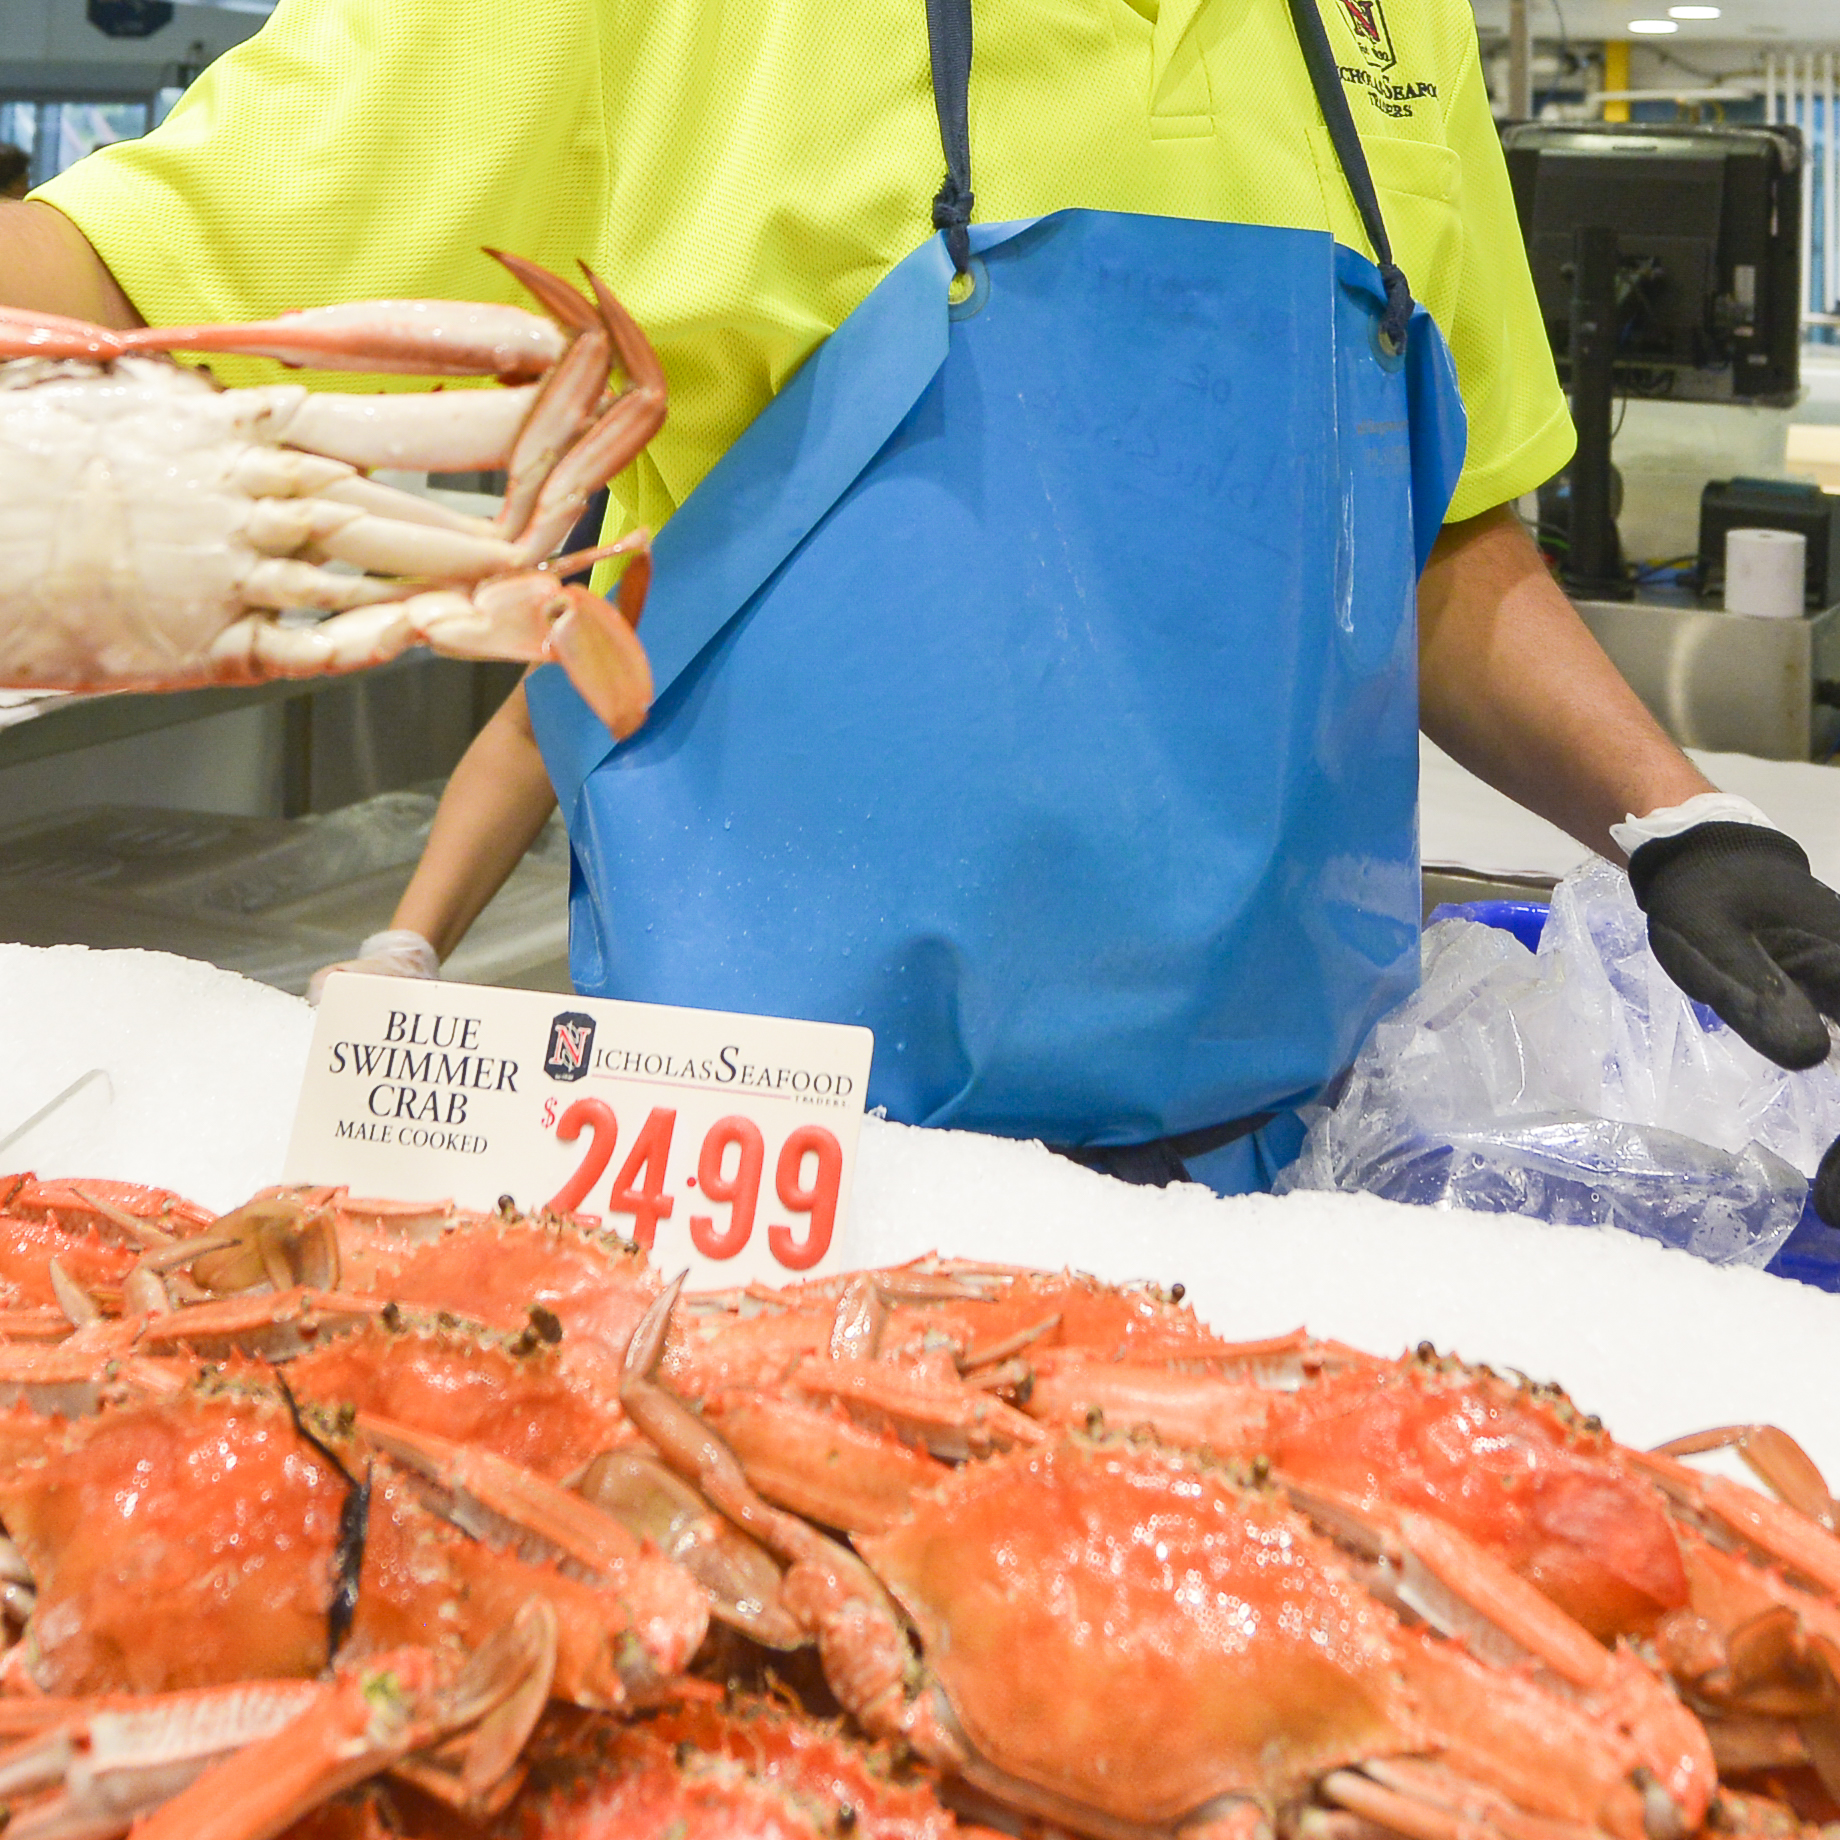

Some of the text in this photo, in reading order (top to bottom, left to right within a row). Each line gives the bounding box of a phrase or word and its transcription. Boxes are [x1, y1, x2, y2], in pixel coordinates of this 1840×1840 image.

[383, 1010, 482, 1051] BLUE
[328, 1040, 520, 1094] SWIMMER
[368, 1083, 468, 1126] CRAB
[334, 1119, 489, 1157] MALE COOKED
